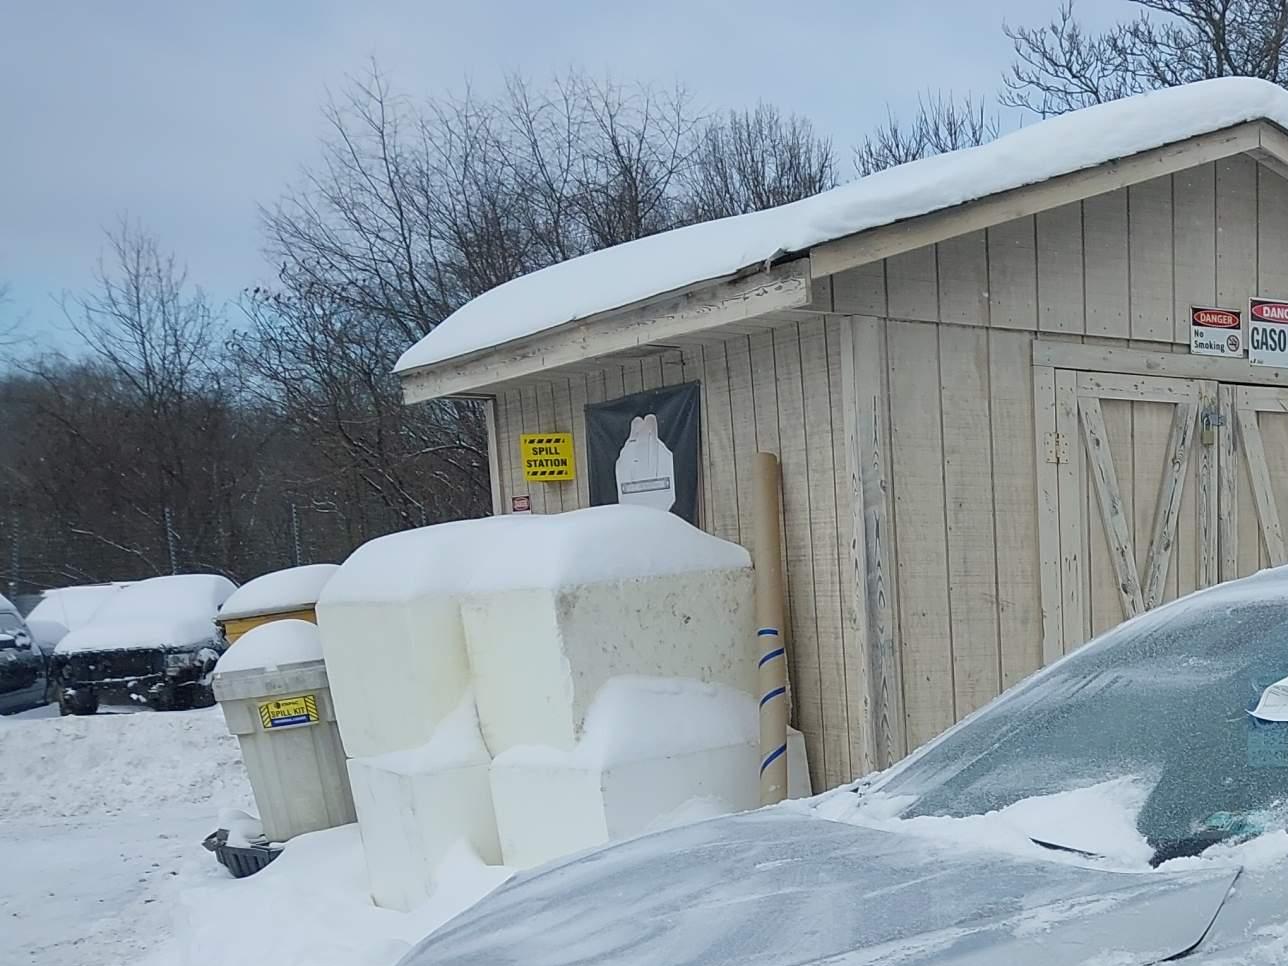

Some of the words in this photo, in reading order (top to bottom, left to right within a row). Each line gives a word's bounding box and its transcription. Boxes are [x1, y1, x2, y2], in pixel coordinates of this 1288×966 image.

[1200, 313, 1233, 325] DANGER
[1194, 328, 1204, 338] No
[1194, 340, 1225, 353] Smoking
[532, 446, 560, 456] SPILL
[526, 458, 568, 468] STATION
[271, 708, 292, 717] SPILL
[294, 707, 305, 716] KIT
